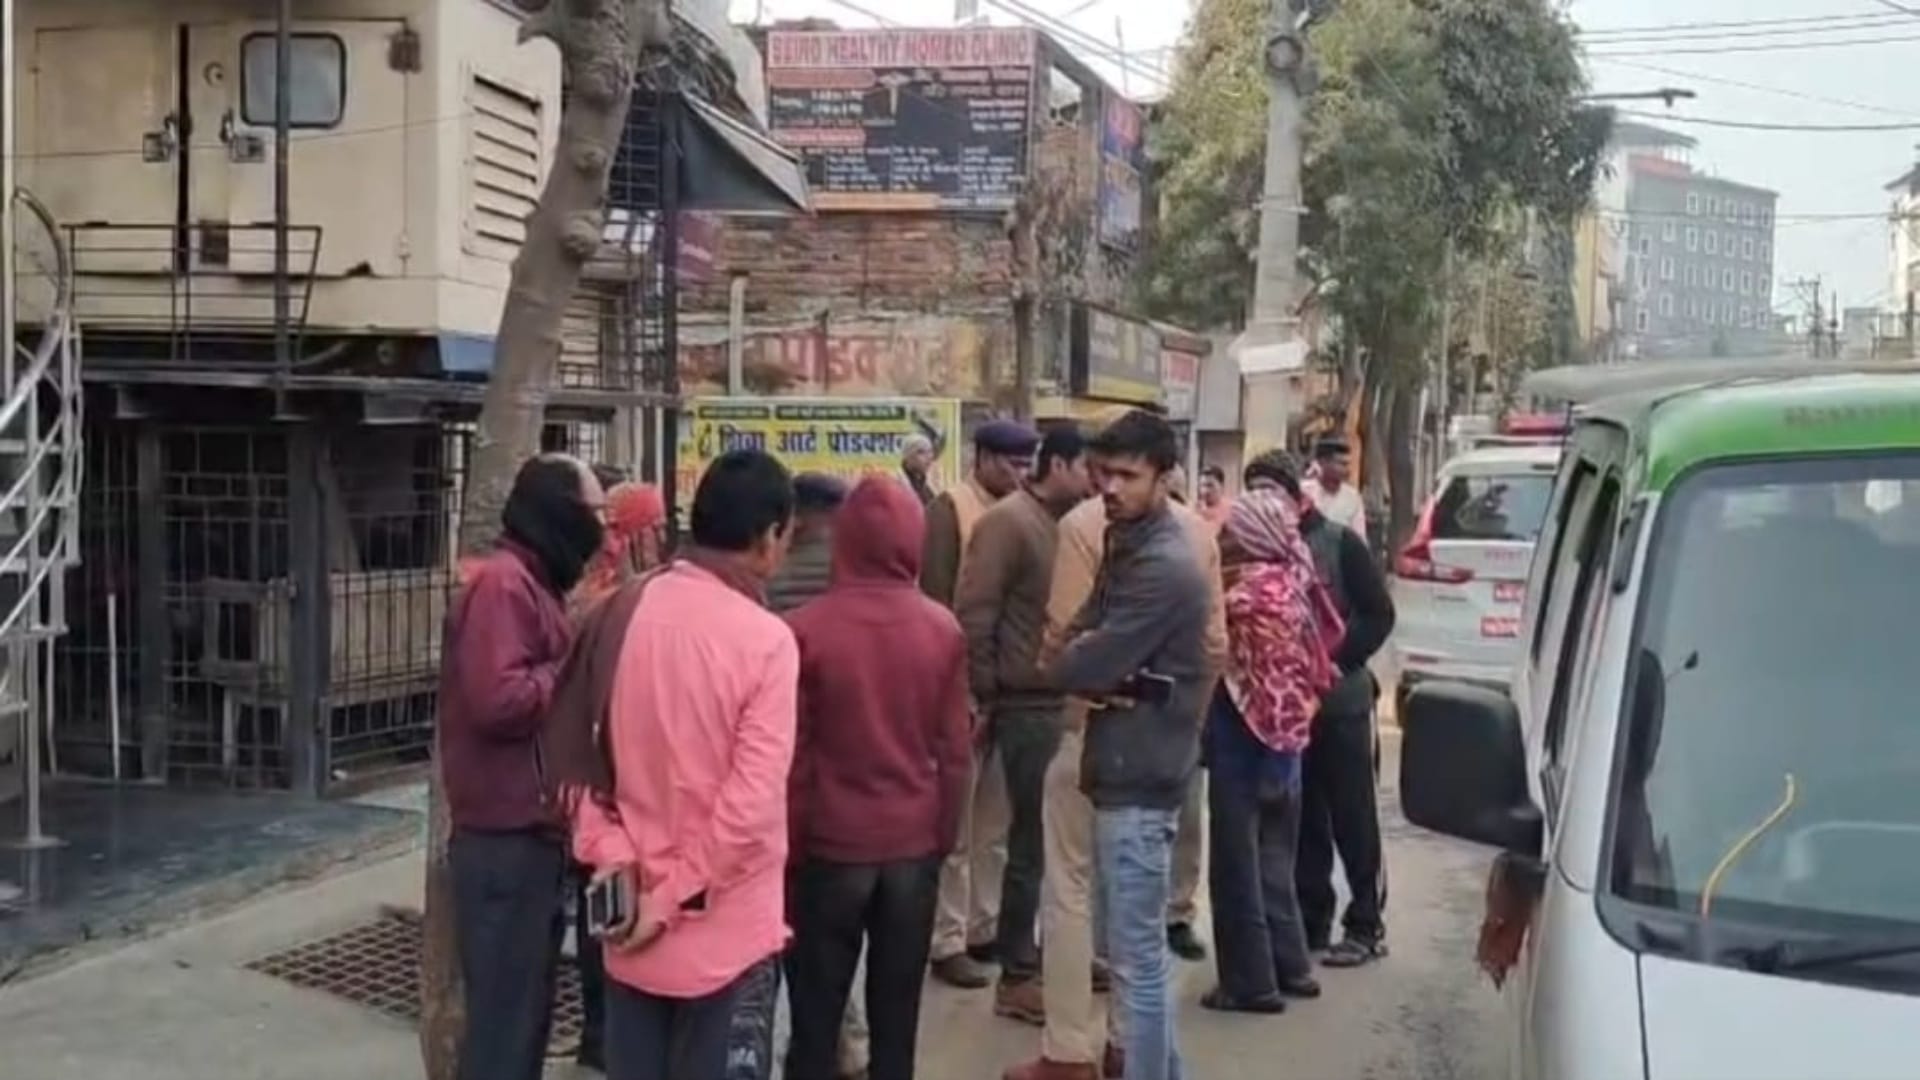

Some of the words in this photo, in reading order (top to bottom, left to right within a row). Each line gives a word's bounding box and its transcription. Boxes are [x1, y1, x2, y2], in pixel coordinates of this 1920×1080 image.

[827, 34, 901, 63] HEALTHY
[908, 33, 966, 62] HOMEO
[969, 32, 1029, 61] CLINIC
[777, 424, 817, 452] आर्ट
